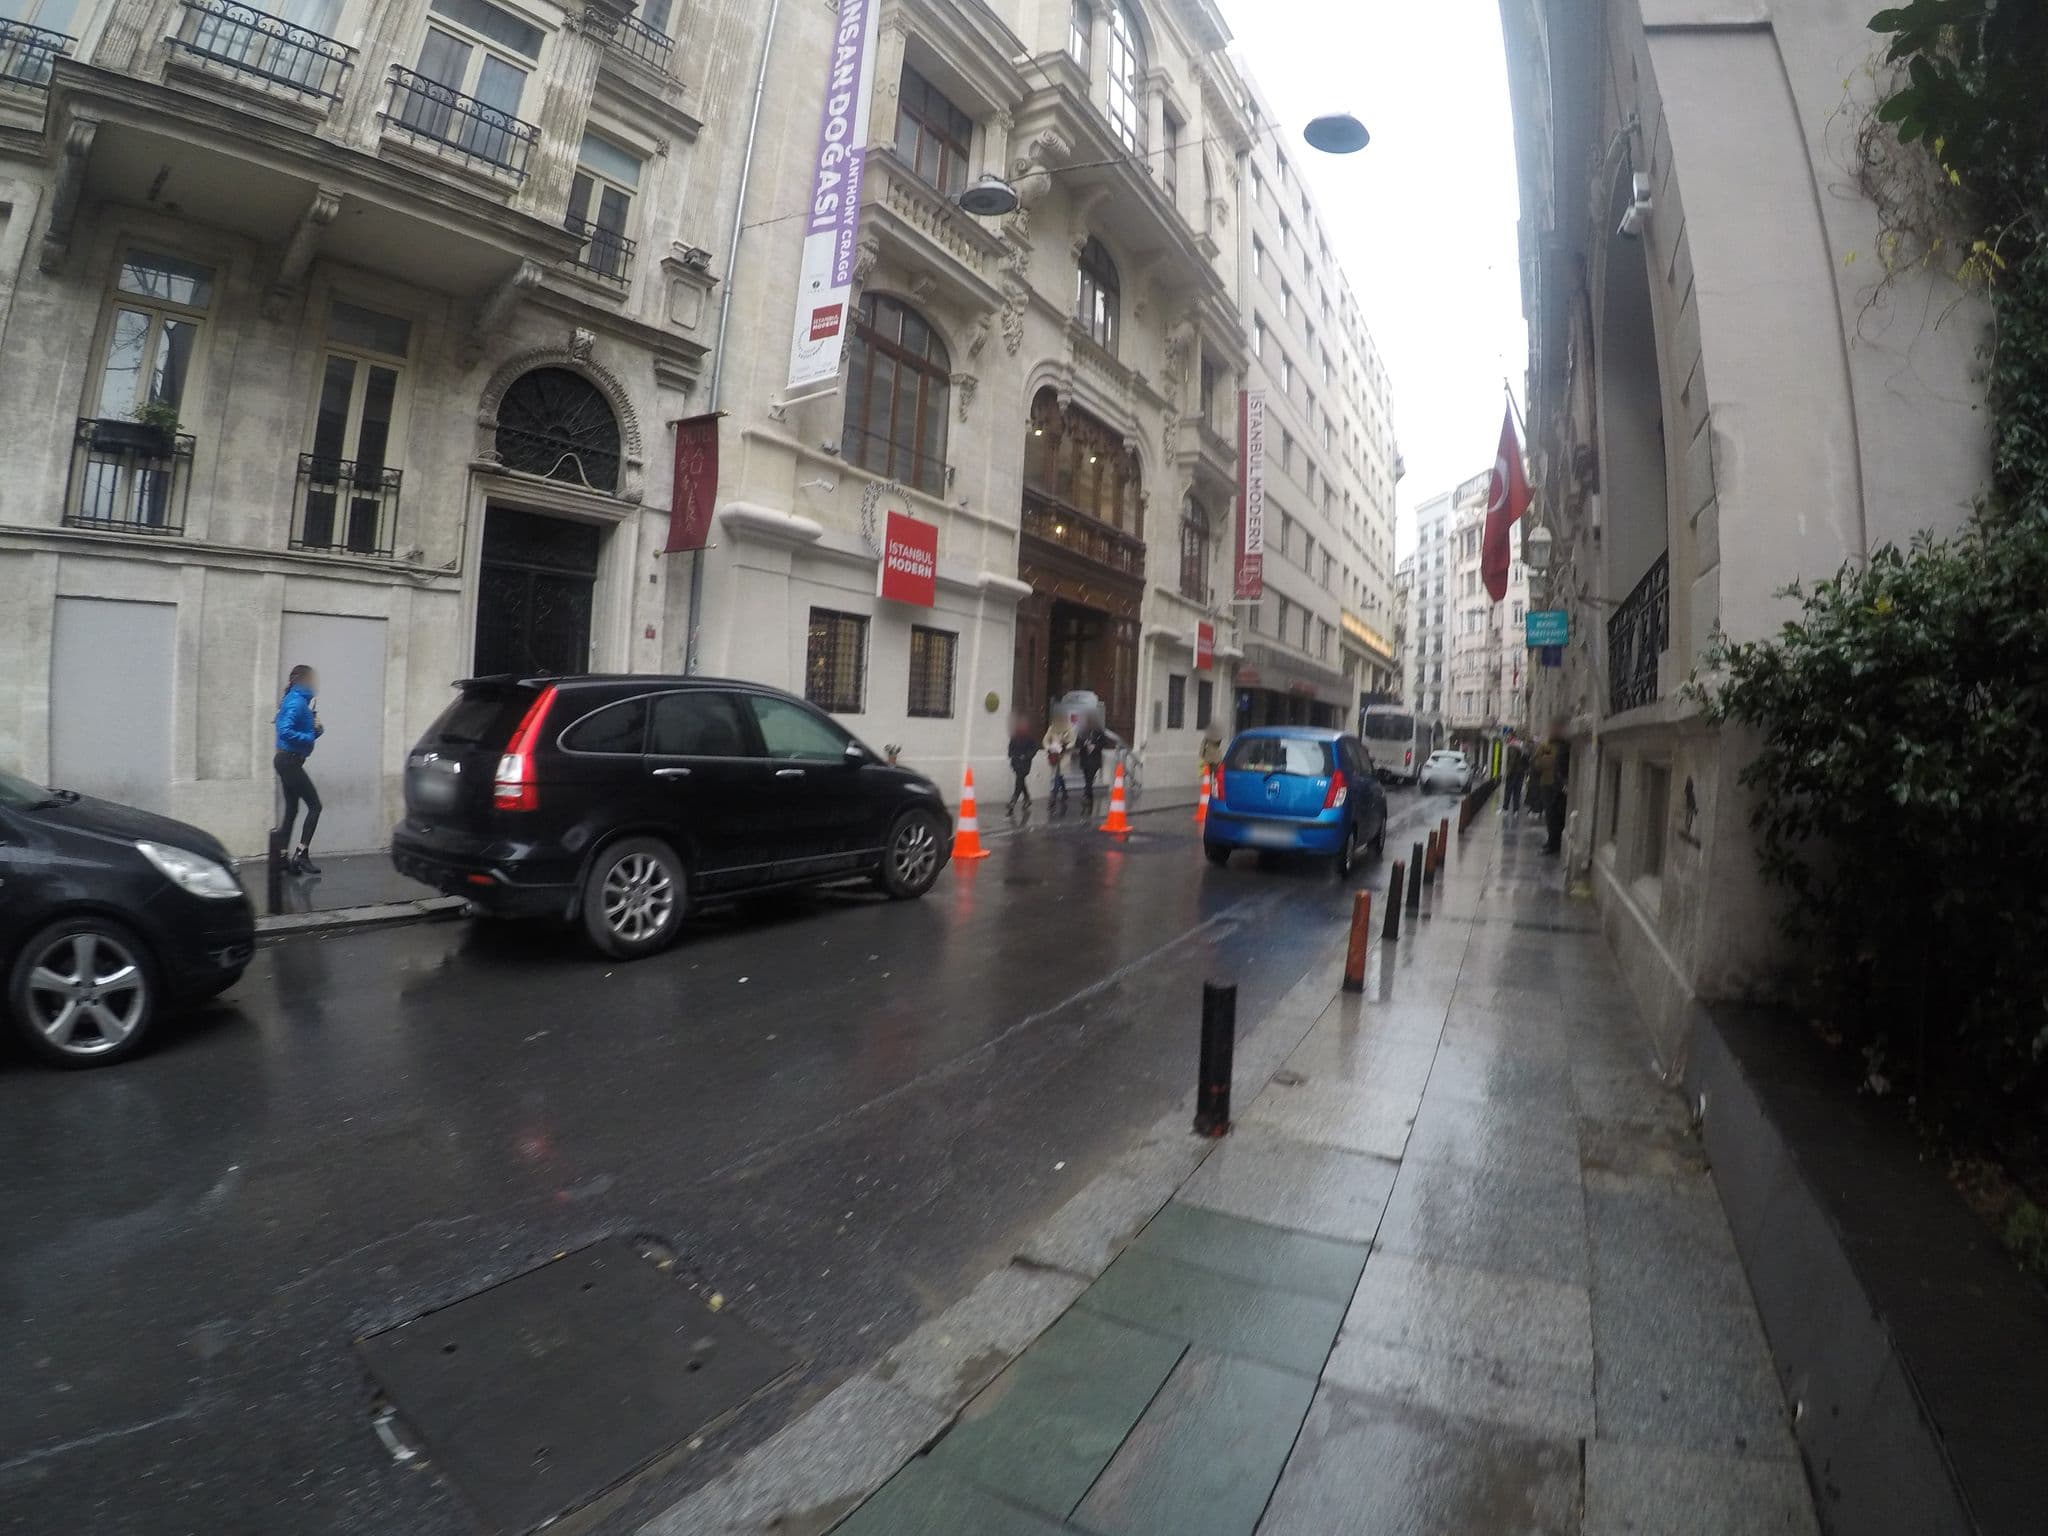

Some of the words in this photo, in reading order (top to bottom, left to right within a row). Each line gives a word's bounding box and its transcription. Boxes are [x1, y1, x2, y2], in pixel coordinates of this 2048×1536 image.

[812, 91, 853, 228] DOĞASI
[843, 157, 860, 225] ANTHONY
[837, 230, 852, 282] CRAGG
[1248, 477, 1262, 551] MODERN
[887, 555, 933, 579] MODERN
